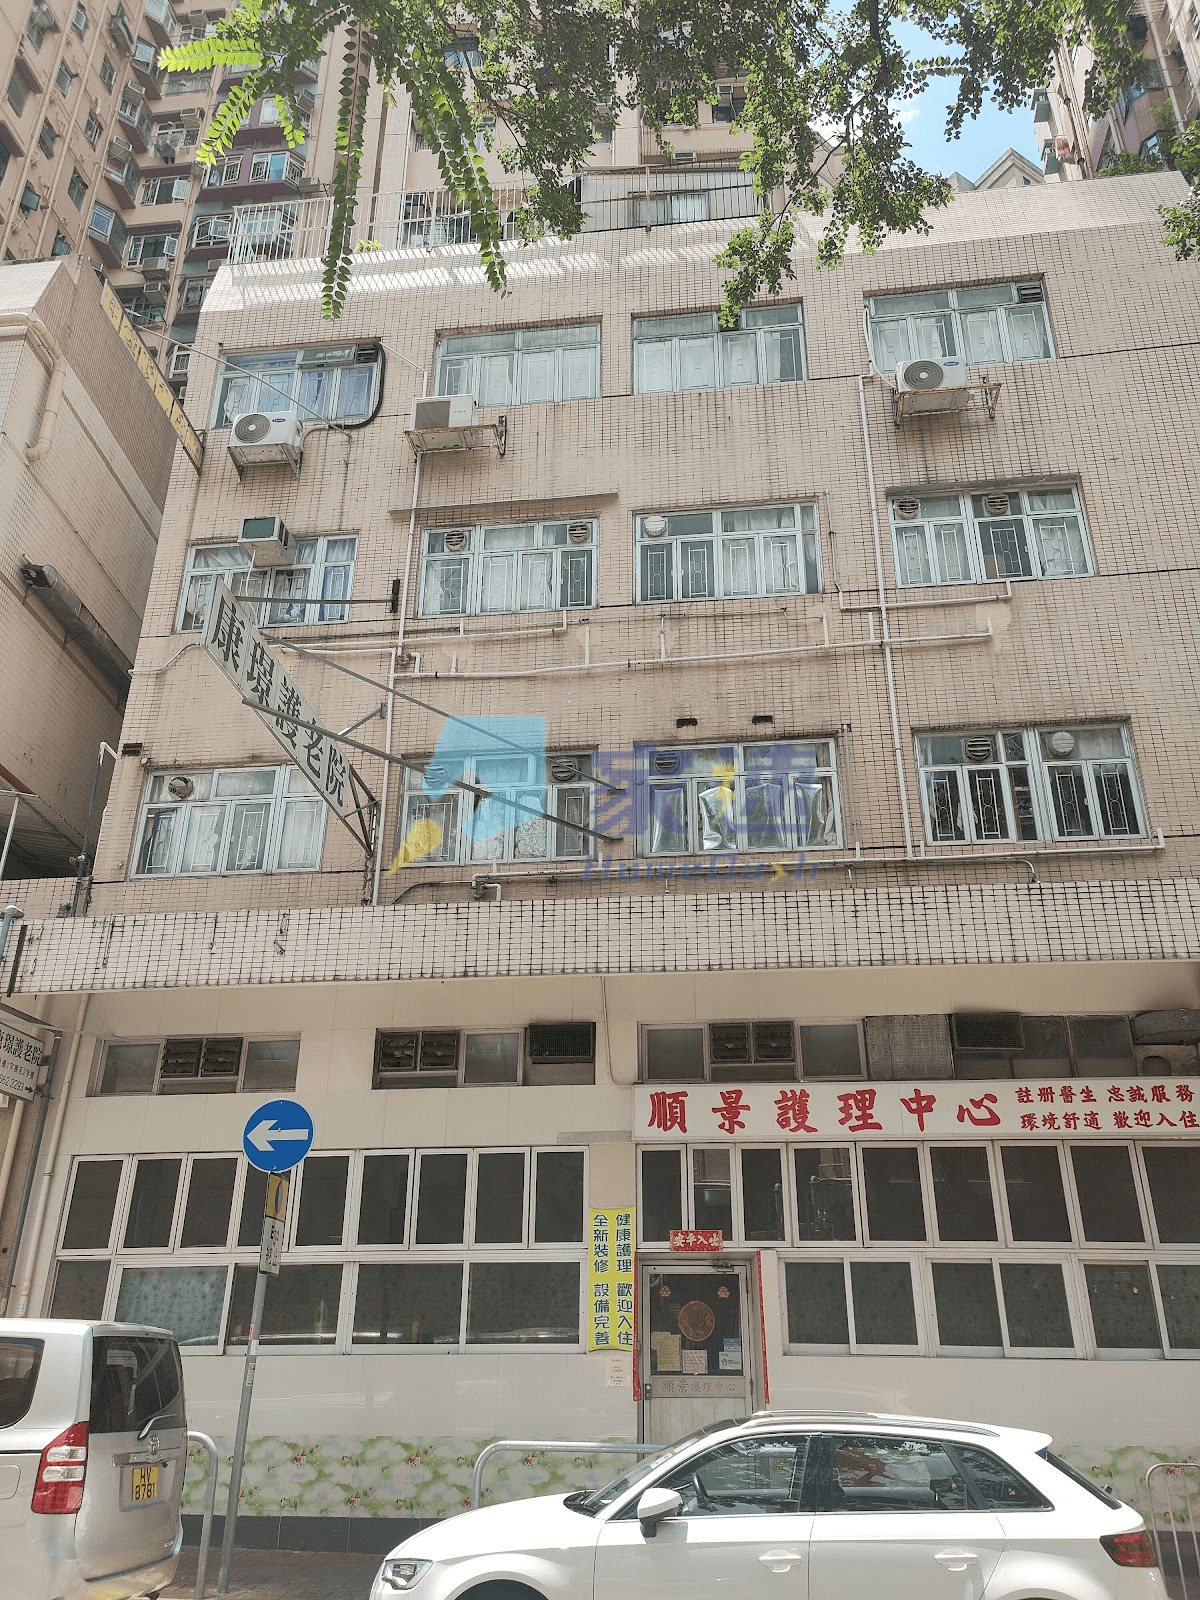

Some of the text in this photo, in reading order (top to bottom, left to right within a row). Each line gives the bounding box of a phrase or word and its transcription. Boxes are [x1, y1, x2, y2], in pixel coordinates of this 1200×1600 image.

[211, 595, 345, 808] 康璟護老院
[1107, 1084, 1195, 1104] 忠誠服務
[647, 1088, 1001, 1135] 順景護理中心
[1020, 1110, 1103, 1131] 環境舒適
[615, 1213, 632, 1273] 健康護理
[593, 1214, 610, 1346] 全新裝修 設備完善
[617, 1282, 633, 1346] 歡迎入住
[661, 1378, 736, 1393] 順景護理中心
[135, 1483, 155, 1500] 8781
[140, 1467, 152, 1483] HV
